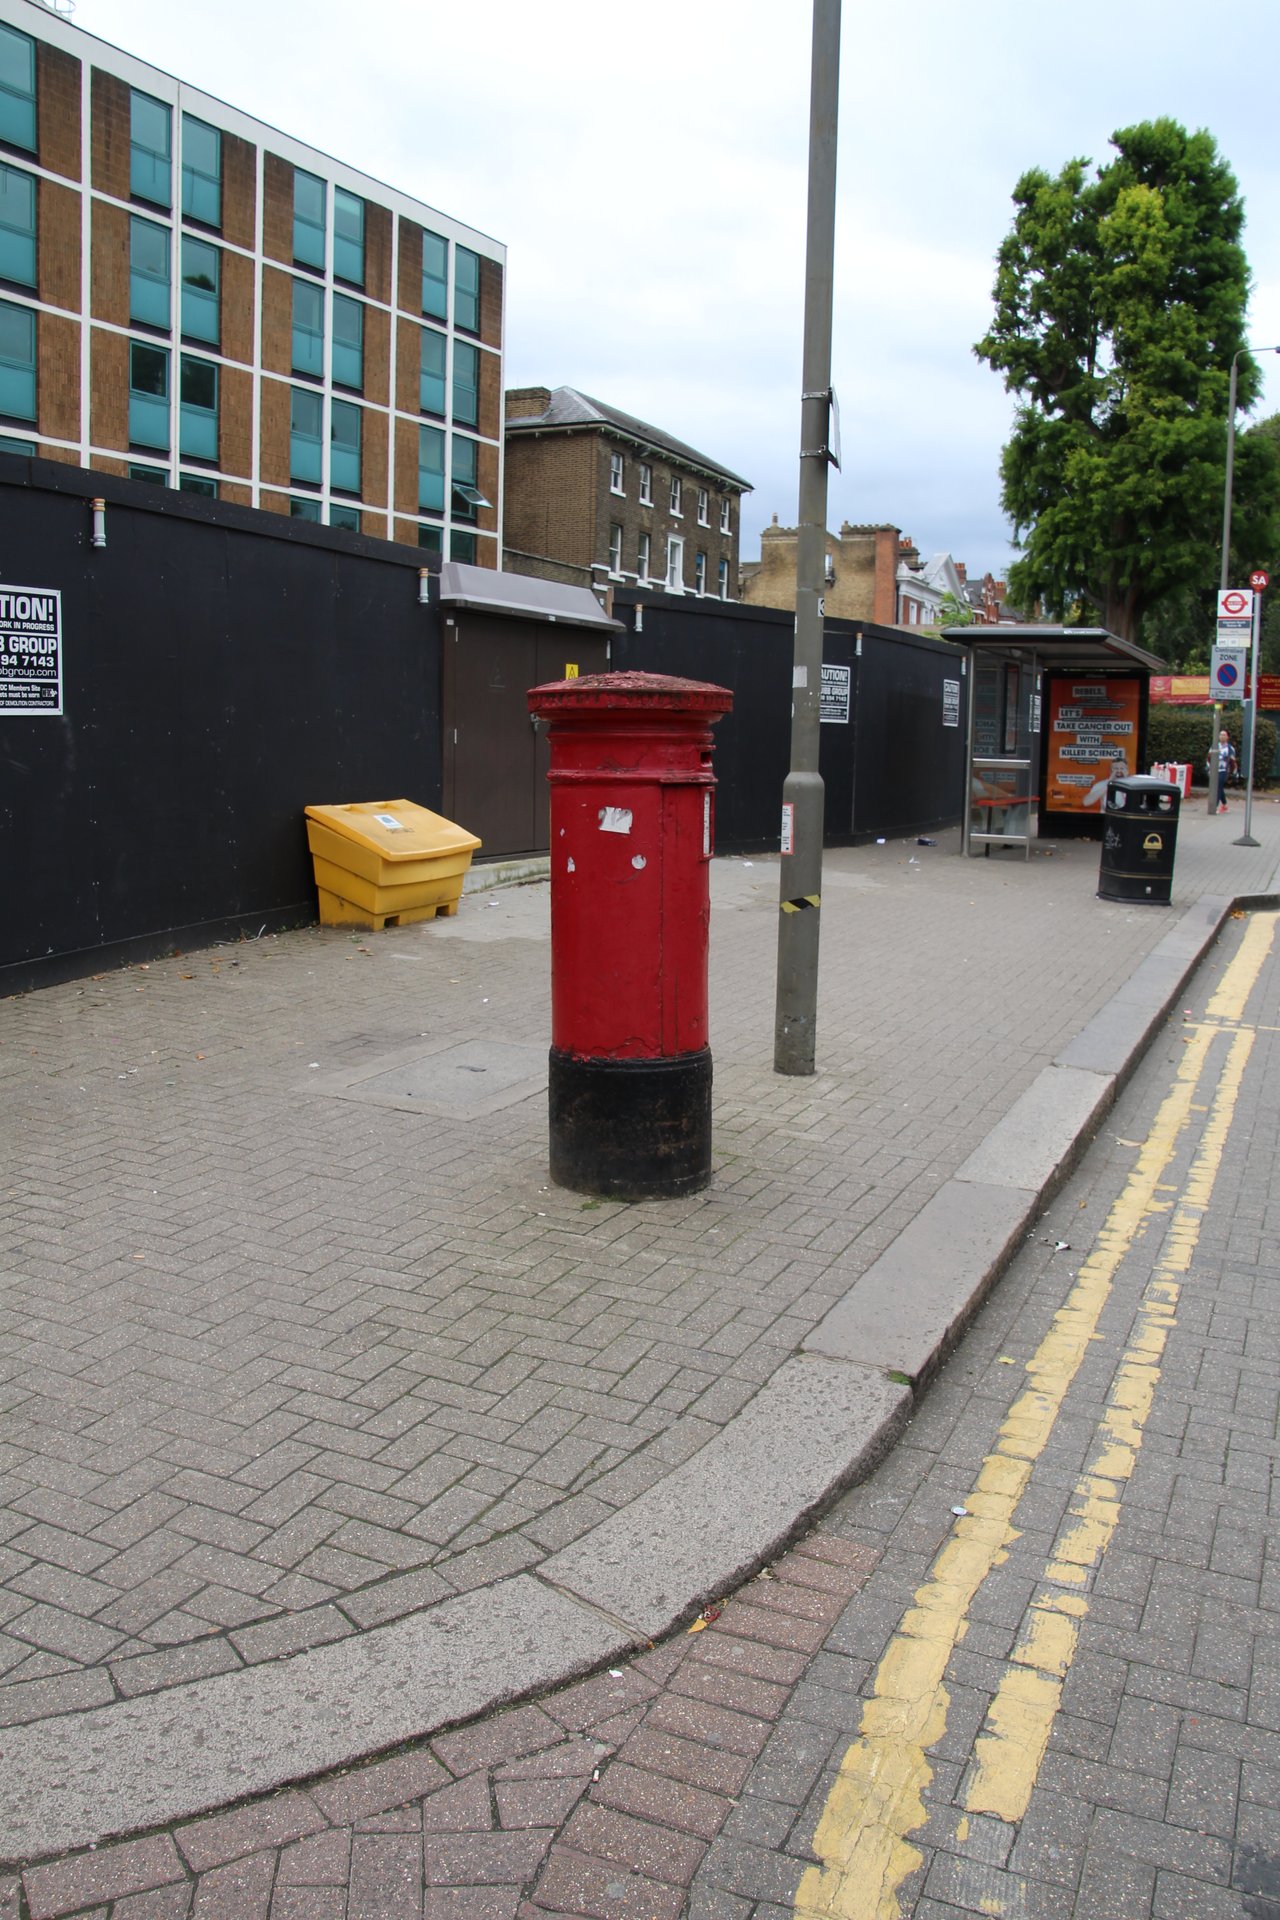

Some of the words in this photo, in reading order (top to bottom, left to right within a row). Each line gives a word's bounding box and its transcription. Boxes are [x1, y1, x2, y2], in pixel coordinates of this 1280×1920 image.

[1252, 575, 1266, 585] SA
[22, 622, 54, 631] PROGRESS
[9, 636, 57, 654] GROUP
[22, 655, 54, 667] 7143
[1061, 709, 1080, 717] LET'S
[1057, 722, 1075, 730] TAKE
[1114, 723, 1131, 731] OUT
[1079, 736, 1100, 744] WITH
[1062, 749, 1086, 757] KILLER
[1089, 749, 1123, 757] SCIENCE
